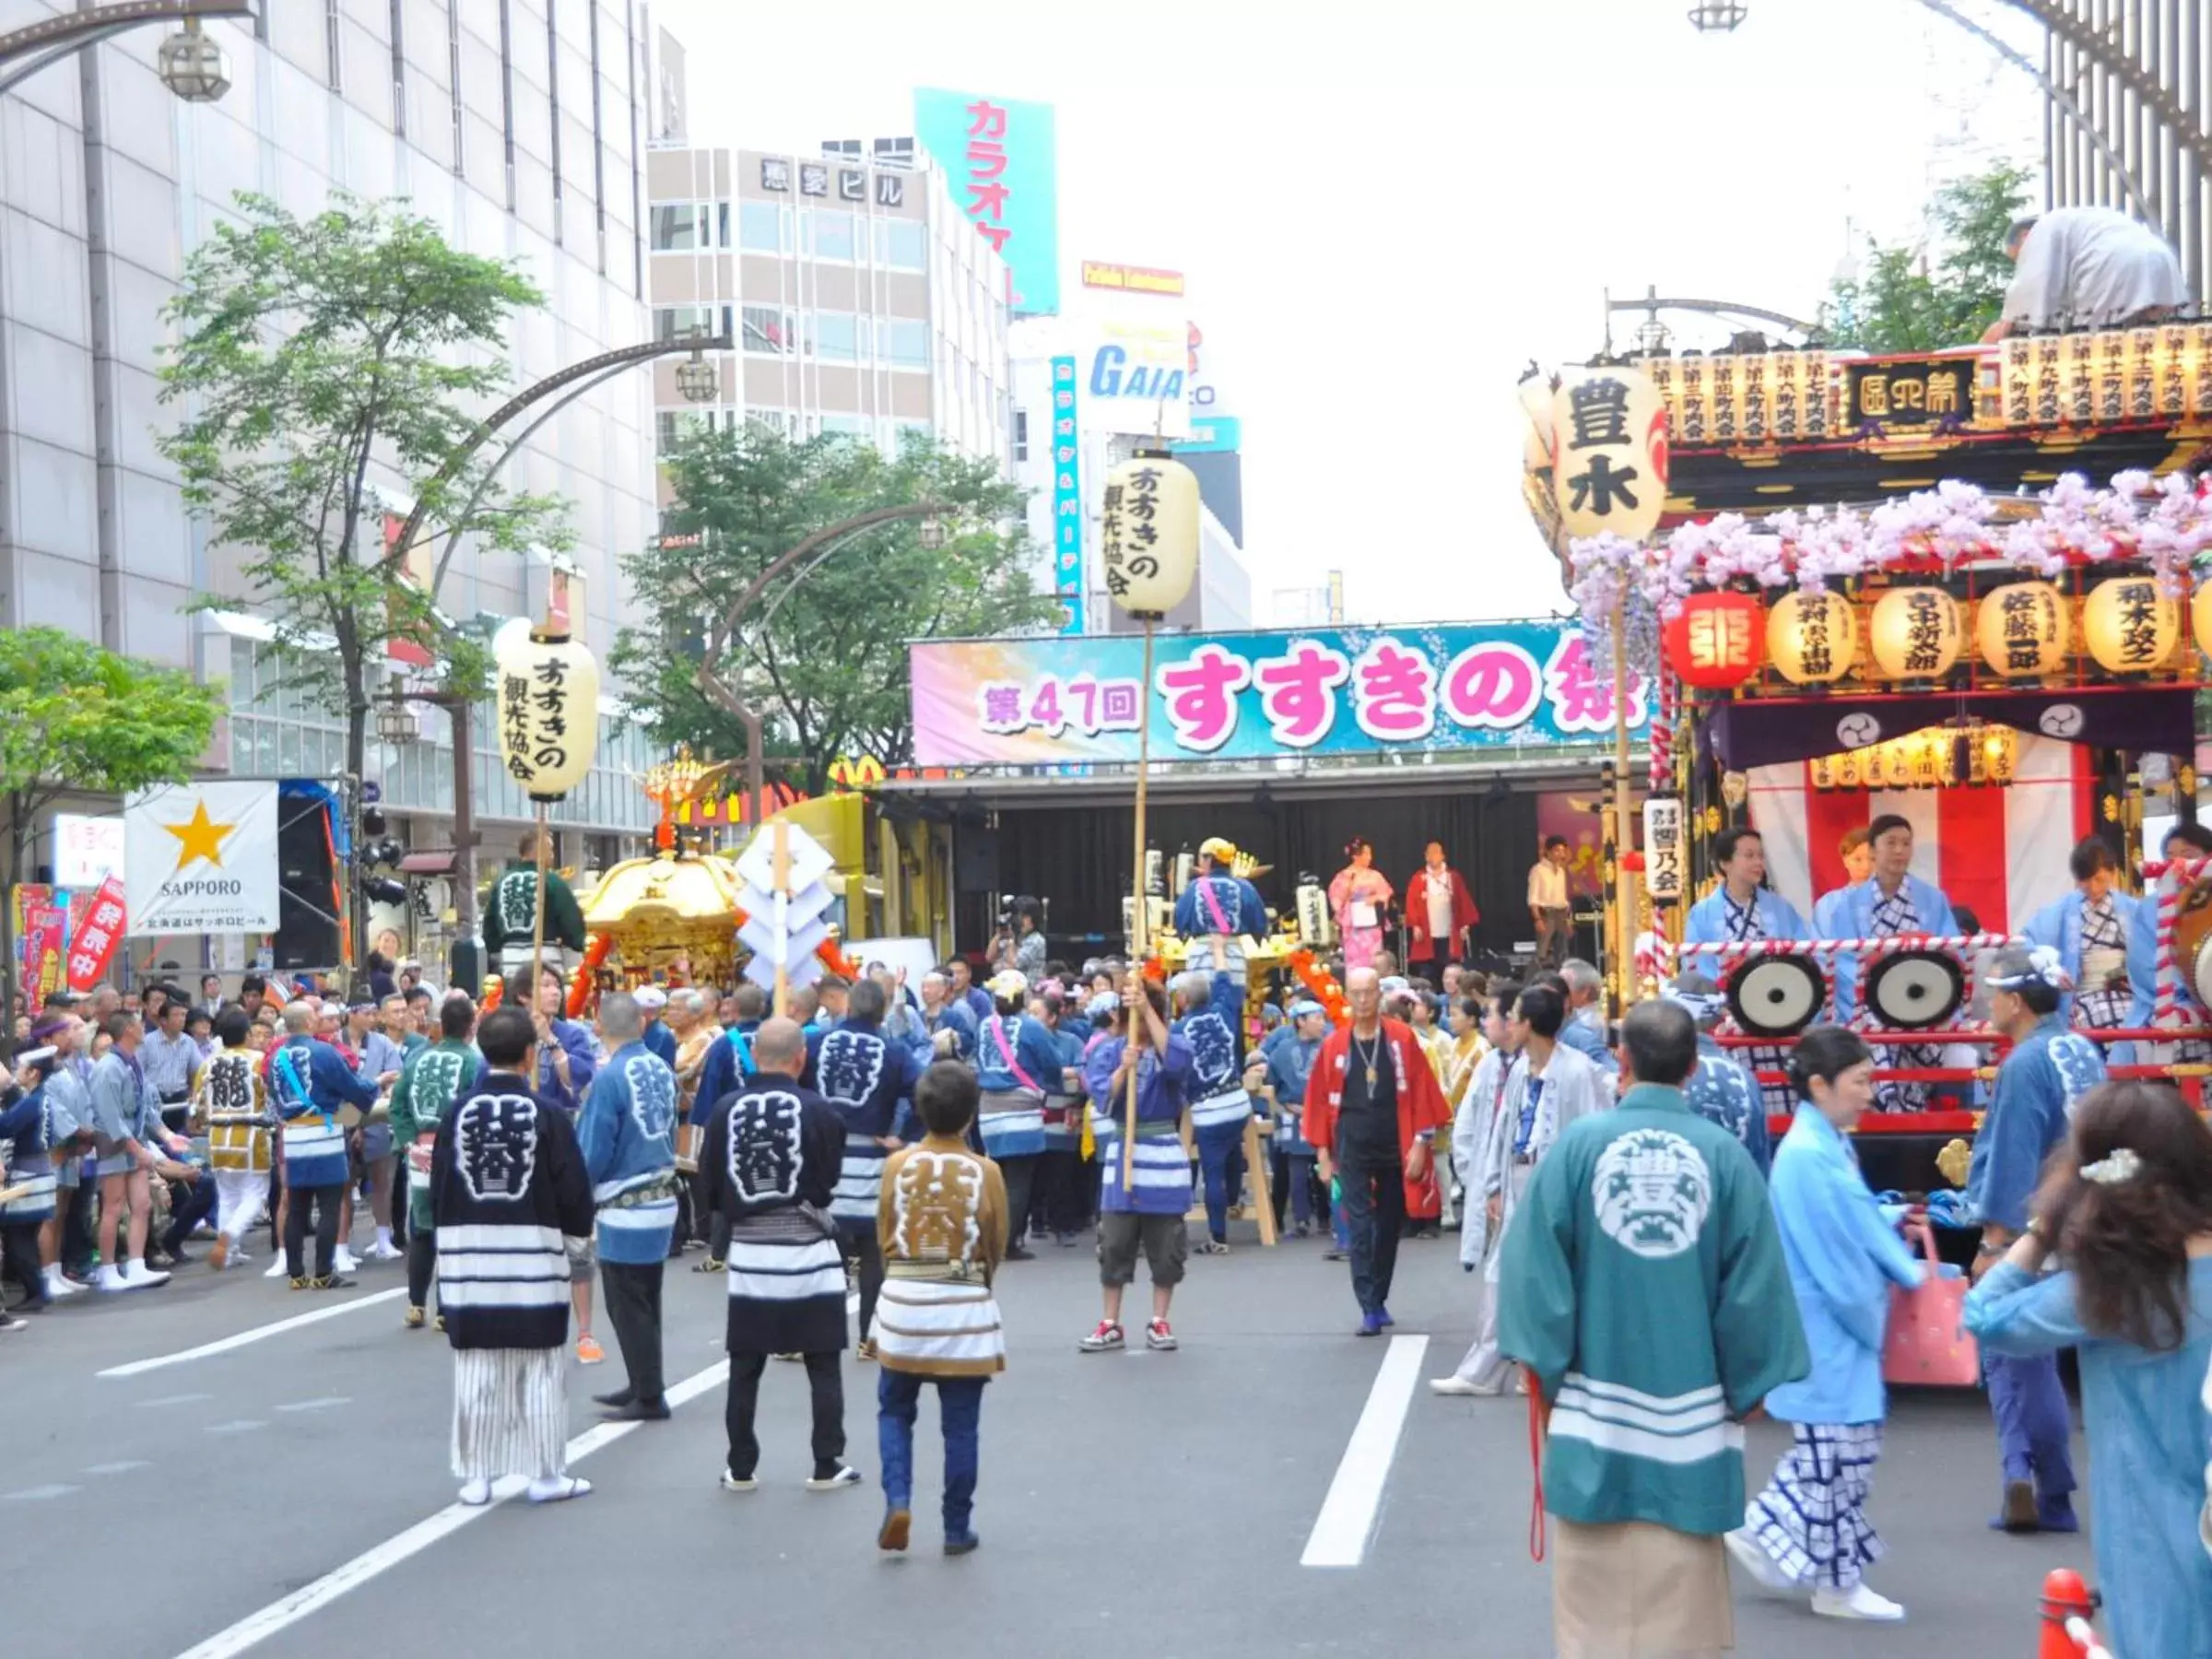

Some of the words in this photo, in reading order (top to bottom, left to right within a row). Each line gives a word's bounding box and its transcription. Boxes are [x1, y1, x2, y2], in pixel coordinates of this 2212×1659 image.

[1089, 345, 1184, 400] GAIA
[1567, 377, 1639, 516] 豊水
[1126, 466, 1164, 580] すすきの
[504, 673, 535, 781] 観光協会
[533, 656, 570, 769] すすきの
[983, 680, 1138, 727] 第47回
[160, 879, 241, 897] SAPPORO
